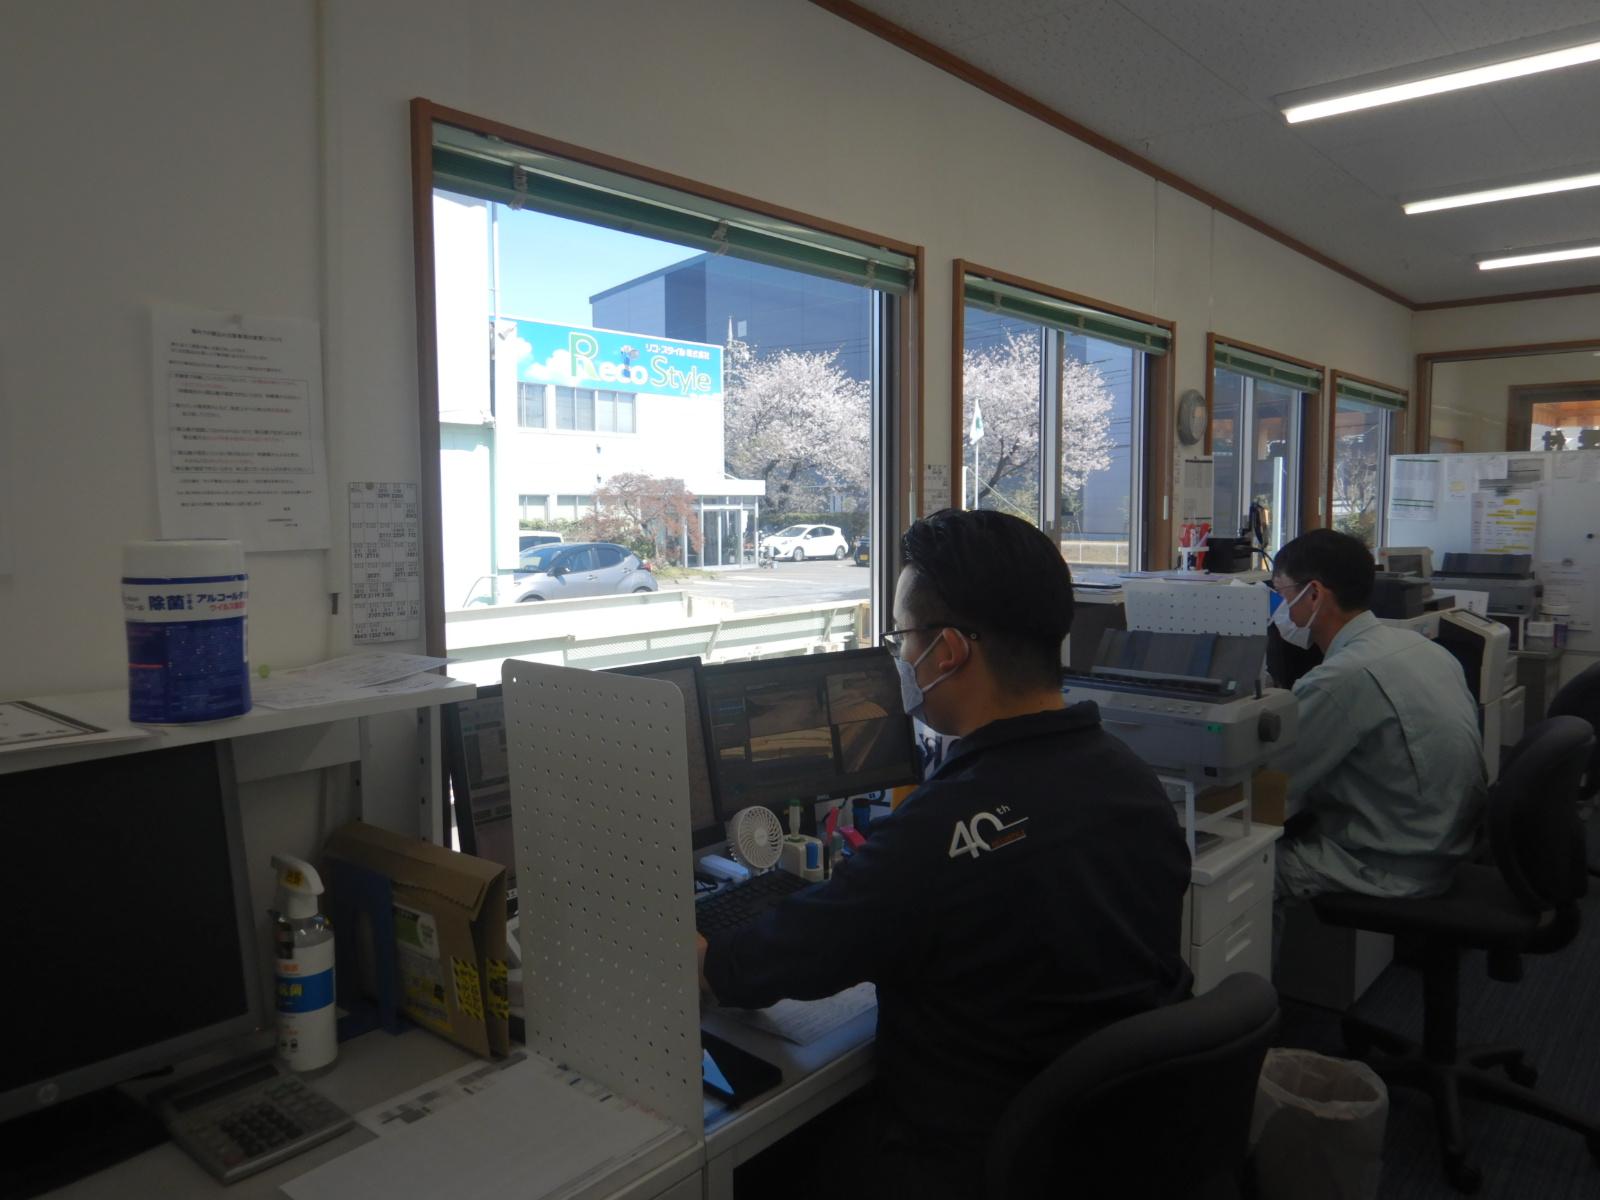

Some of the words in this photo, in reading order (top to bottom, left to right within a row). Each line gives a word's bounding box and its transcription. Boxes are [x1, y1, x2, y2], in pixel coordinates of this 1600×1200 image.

[569, 332, 649, 386] Reco
[650, 355, 711, 395] Style
[148, 594, 185, 611] 除菌
